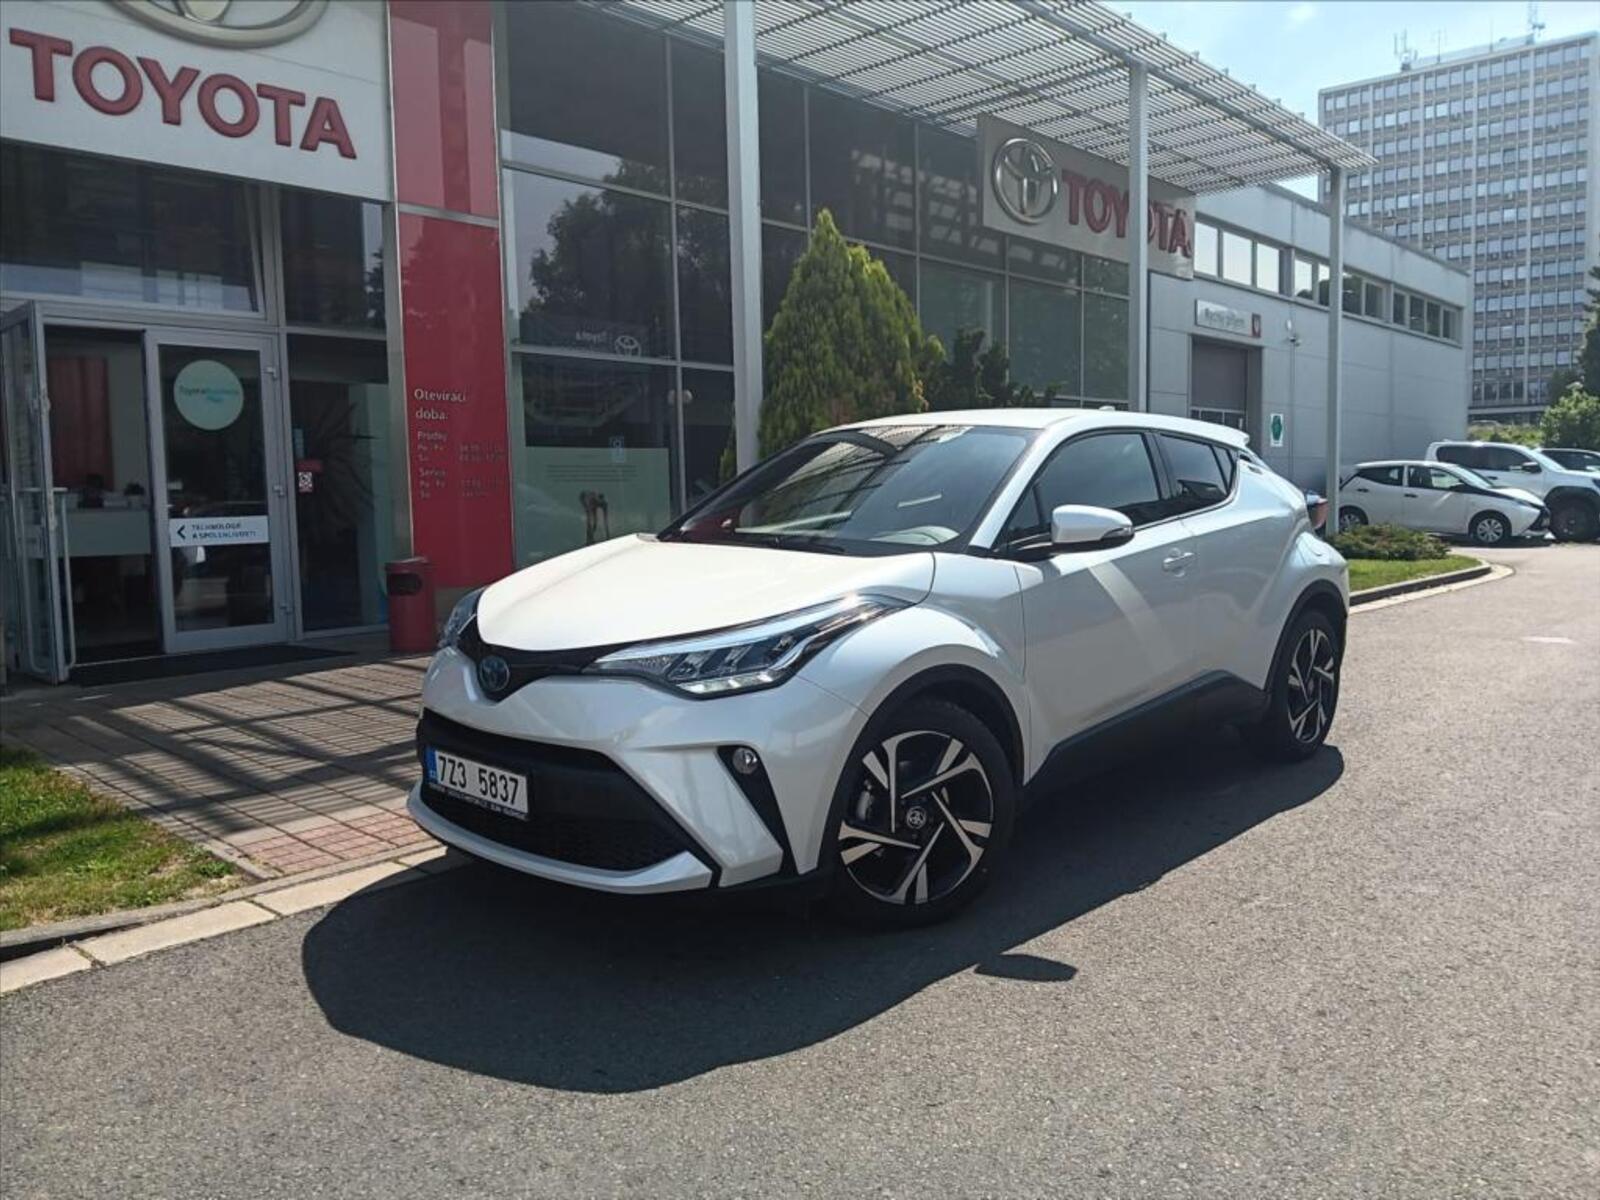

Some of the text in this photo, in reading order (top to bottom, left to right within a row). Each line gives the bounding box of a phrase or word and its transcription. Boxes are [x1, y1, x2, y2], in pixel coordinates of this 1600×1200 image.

[9, 28, 357, 159] TOYOTA
[1061, 168, 1192, 259] TOYTA
[438, 755, 519, 806] 7Z3 5837
